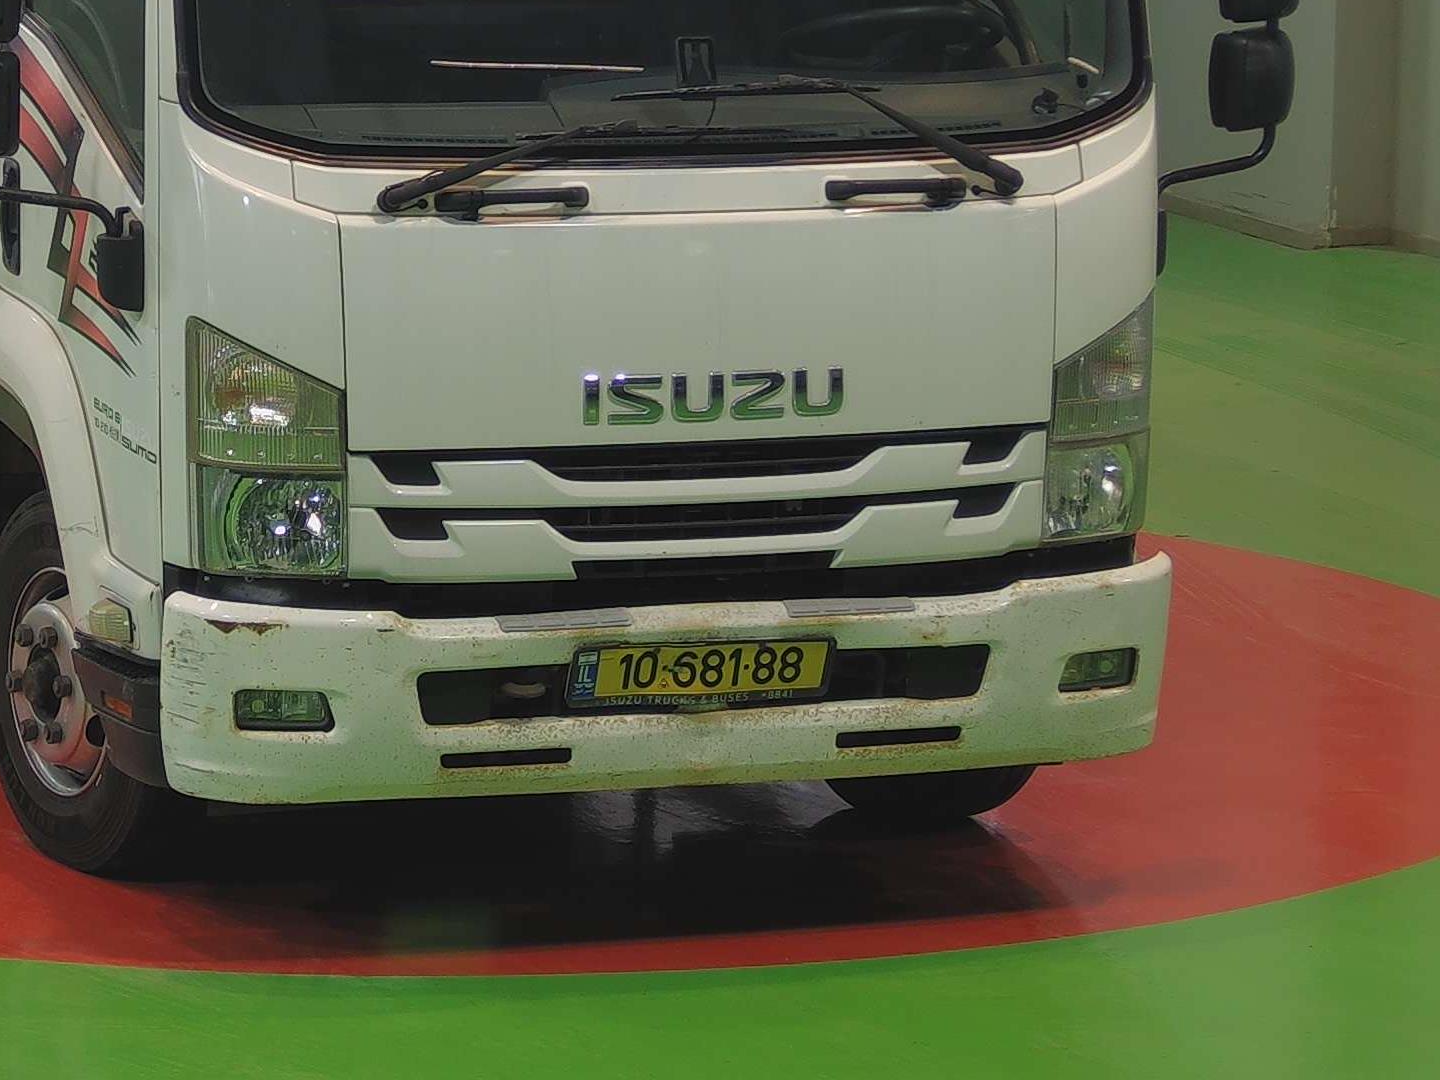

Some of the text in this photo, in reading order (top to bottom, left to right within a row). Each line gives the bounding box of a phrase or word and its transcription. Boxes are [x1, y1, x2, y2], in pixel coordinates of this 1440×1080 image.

[582, 366, 844, 426] ISUZU
[121, 435, 157, 465] SUMO
[605, 695, 642, 706] ISUZU
[712, 693, 750, 704] BUSES
